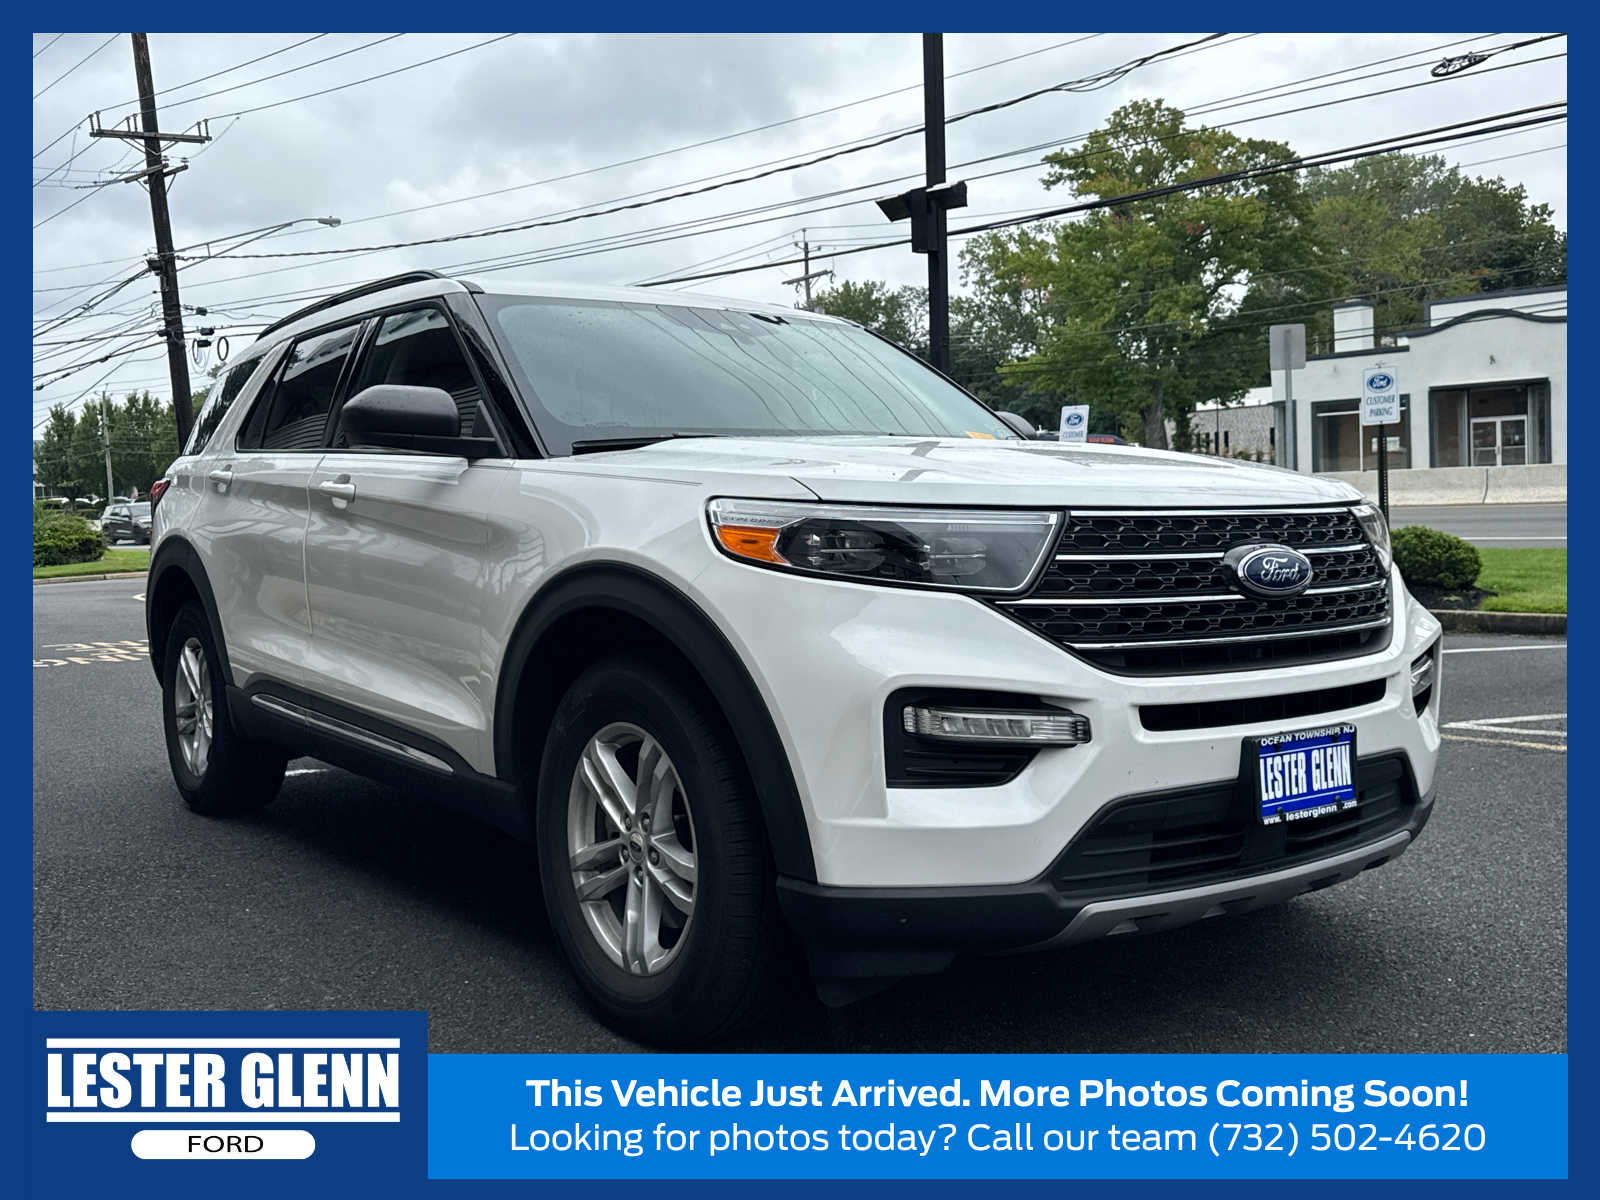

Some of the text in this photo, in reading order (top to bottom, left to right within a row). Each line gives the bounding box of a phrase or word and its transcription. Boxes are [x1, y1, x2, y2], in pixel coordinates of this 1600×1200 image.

[1366, 394, 1395, 406] CUSTOMER
[1369, 407, 1393, 417] PARKING
[1260, 557, 1301, 582] Ford
[1261, 735, 1292, 746] OCEAN
[1343, 724, 1355, 735] NJ
[1260, 744, 1352, 801] LESTER GLENN
[1285, 804, 1337, 822] lesterglenn
